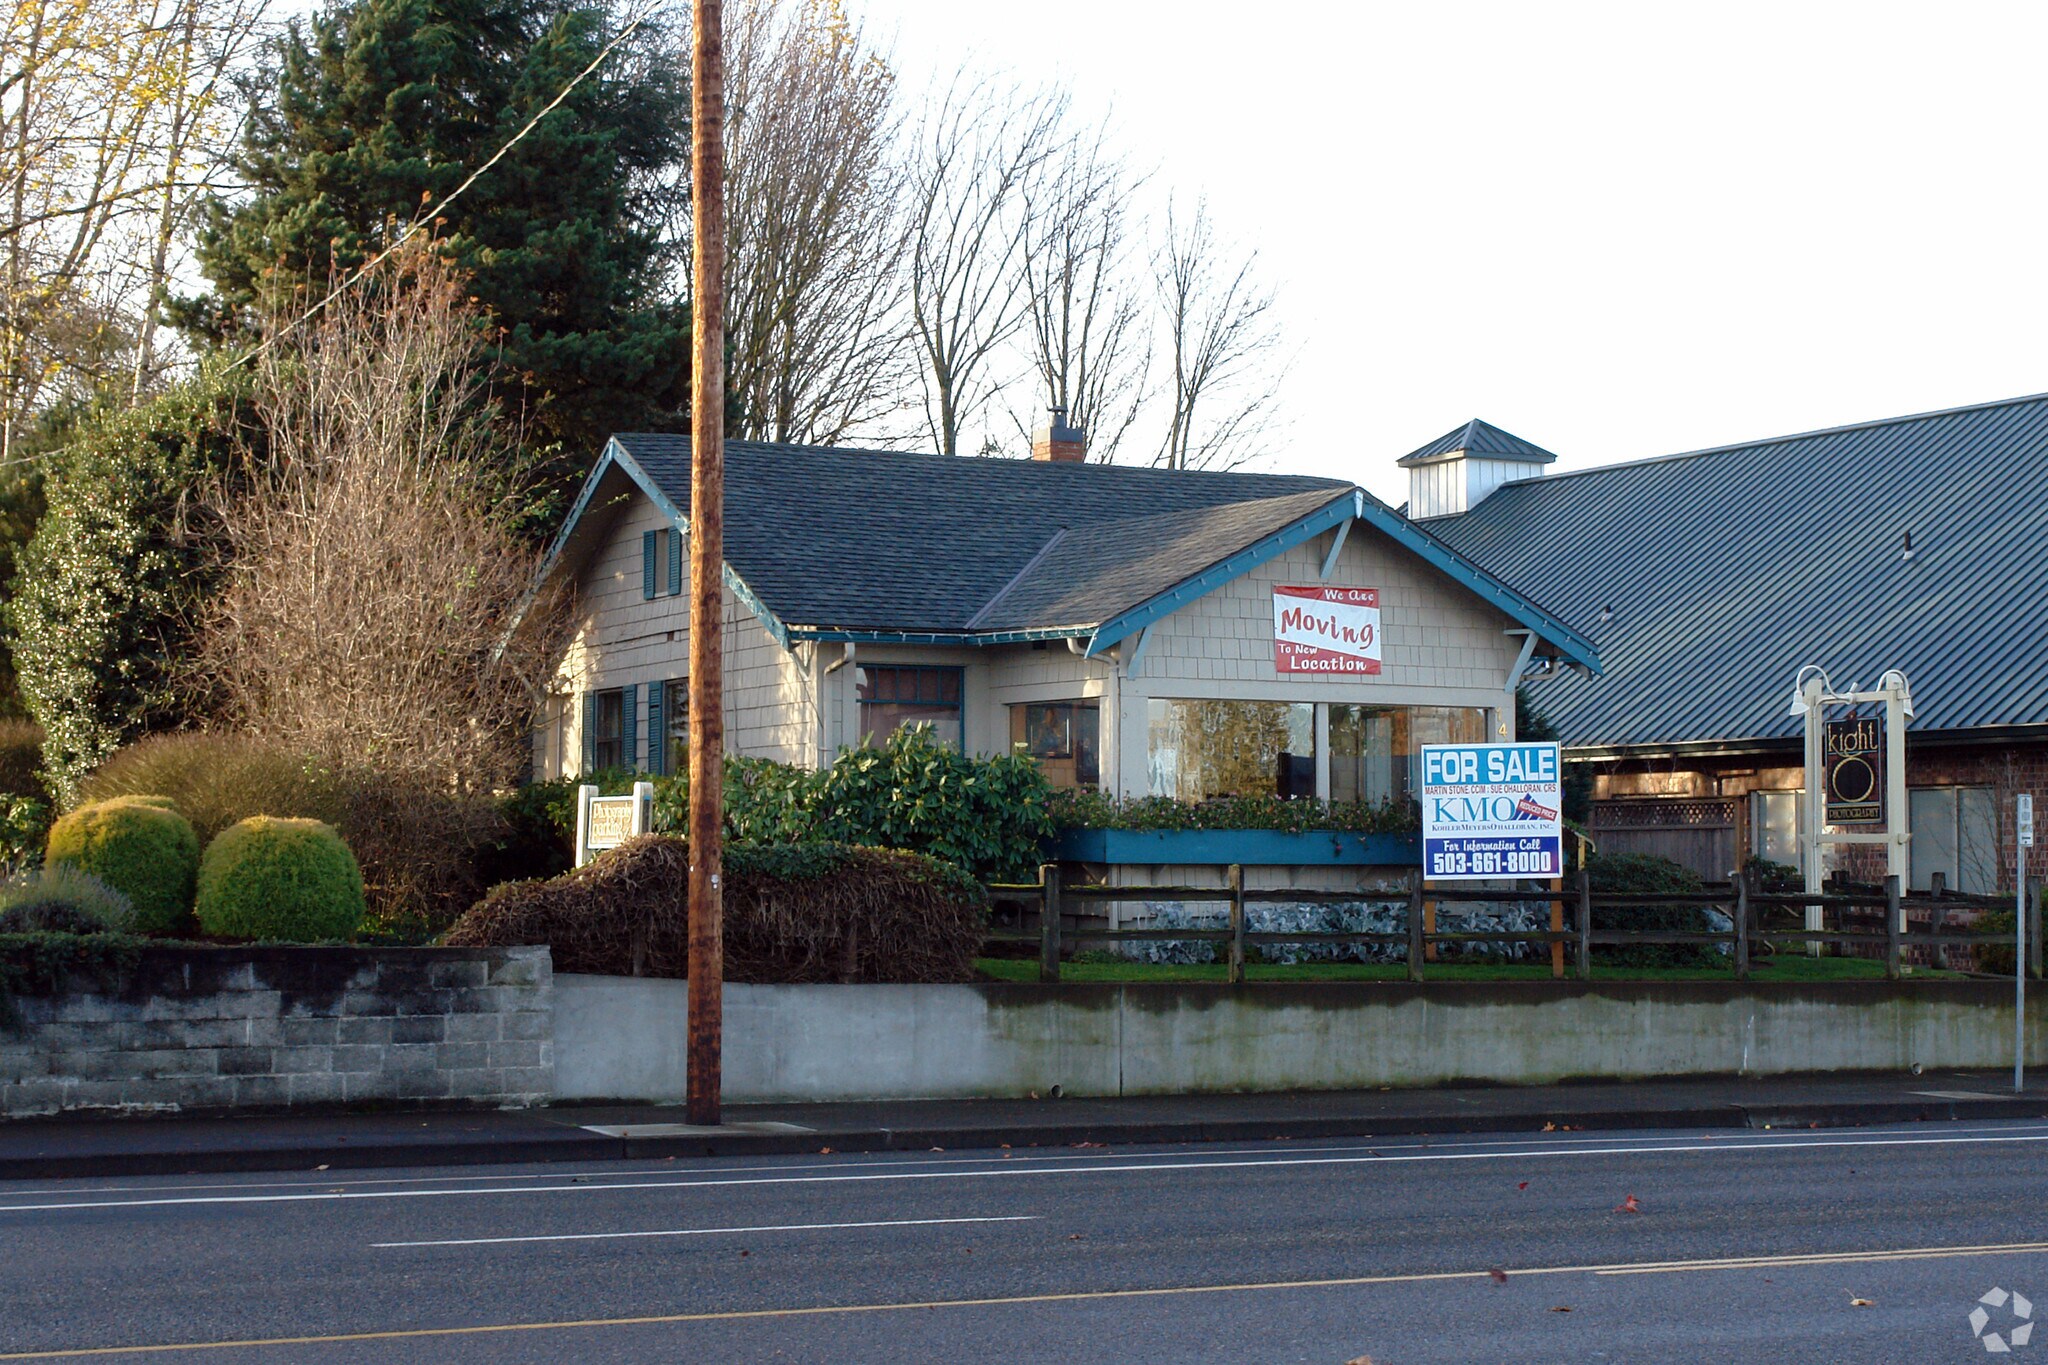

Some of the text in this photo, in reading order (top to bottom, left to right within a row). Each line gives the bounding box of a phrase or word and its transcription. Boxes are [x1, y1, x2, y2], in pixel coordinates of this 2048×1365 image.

[1324, 589, 1375, 601] We Are
[1281, 606, 1374, 650] Moving
[1278, 643, 1318, 654] To New
[1290, 655, 1367, 671] Location
[1828, 721, 1878, 757] kight
[1426, 749, 1555, 784] FOR SALE
[1425, 786, 1448, 795] MARTIN
[1490, 784, 1503, 794] SUE
[1544, 783, 1556, 793] CRS
[1432, 796, 1517, 823] KMO
[1443, 838, 1541, 852] For Information Call
[1434, 851, 1551, 874] 503-661-8000
